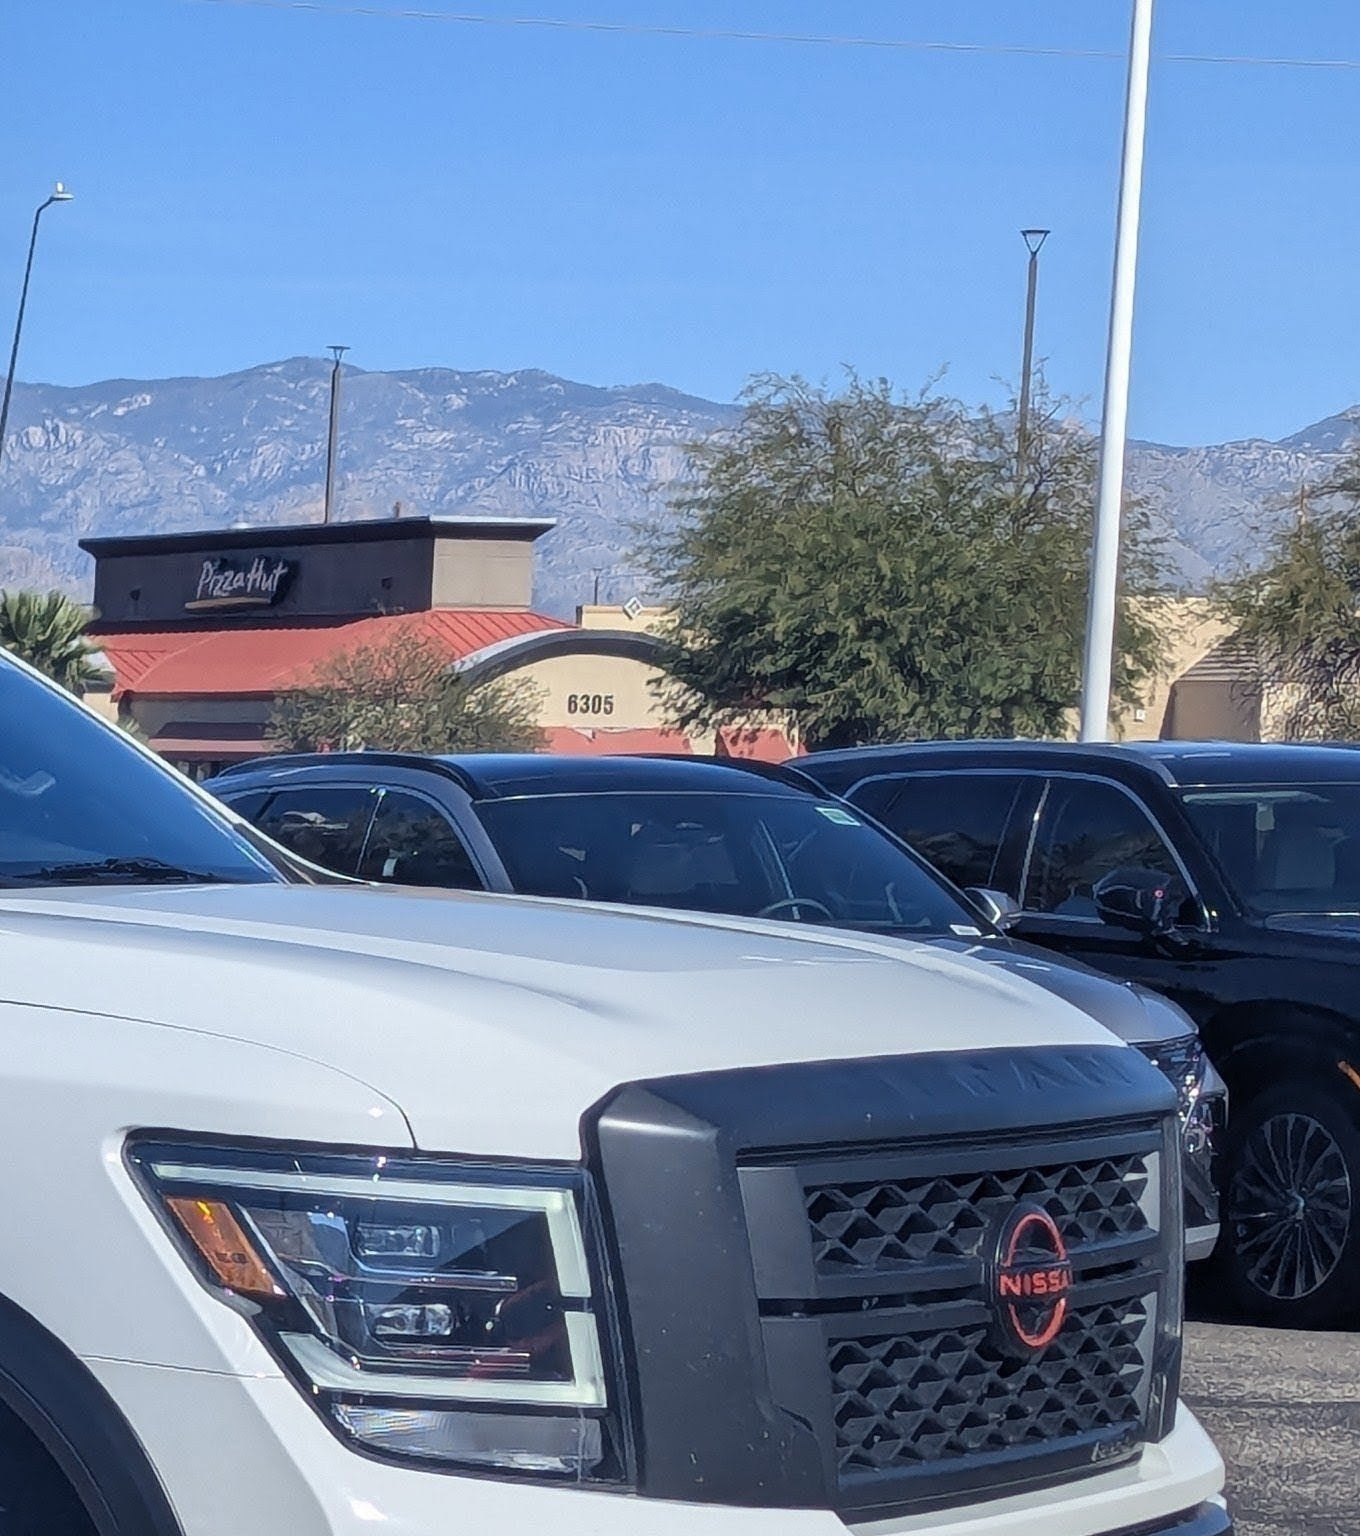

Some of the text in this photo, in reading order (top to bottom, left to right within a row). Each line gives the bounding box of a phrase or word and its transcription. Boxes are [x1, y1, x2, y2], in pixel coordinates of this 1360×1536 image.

[196, 558, 288, 598] Pizza Hut
[567, 694, 614, 715] 6305
